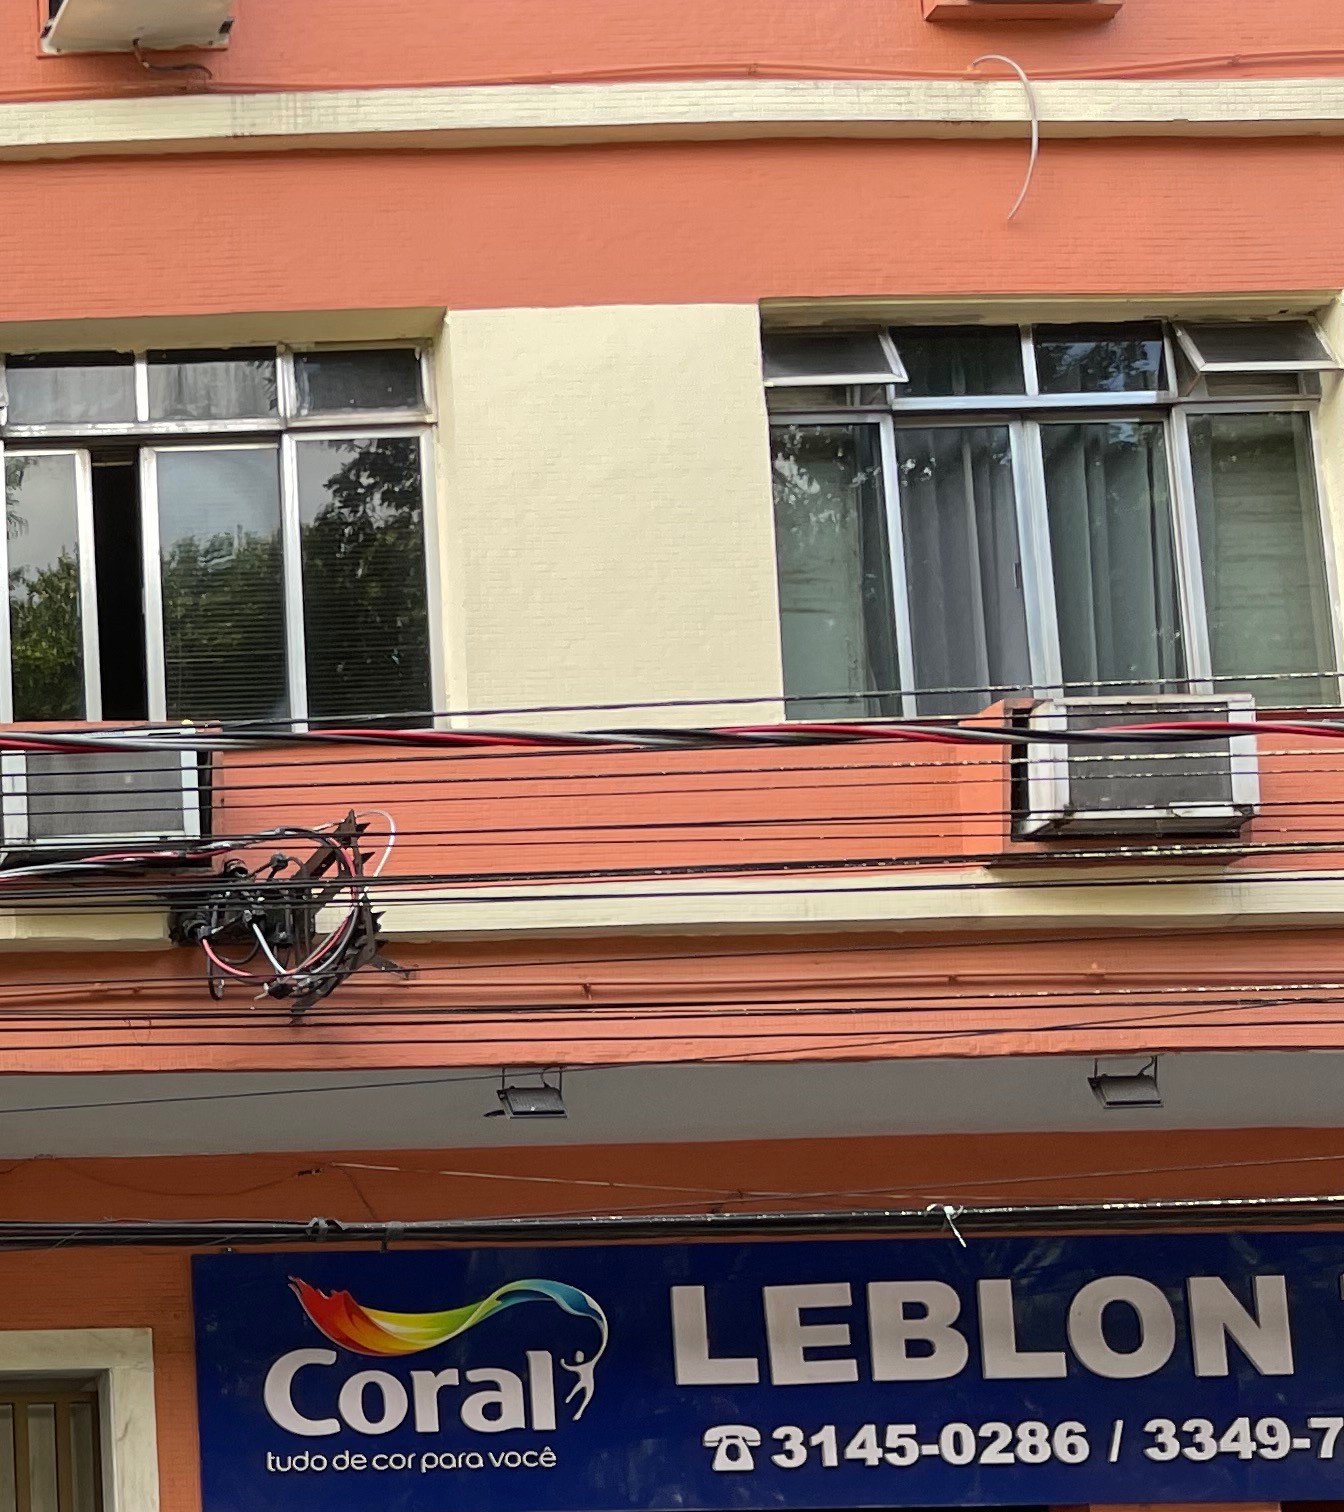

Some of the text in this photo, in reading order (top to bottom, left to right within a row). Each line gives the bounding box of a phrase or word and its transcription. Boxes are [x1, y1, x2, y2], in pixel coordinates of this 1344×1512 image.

[670, 1275, 1295, 1386] LEBLON
[263, 1348, 556, 1436] Coral
[266, 1446, 557, 1473] tudo de cor para você
[771, 1421, 1089, 1468] 3145-0286
[1108, 1419, 1124, 1463] /
